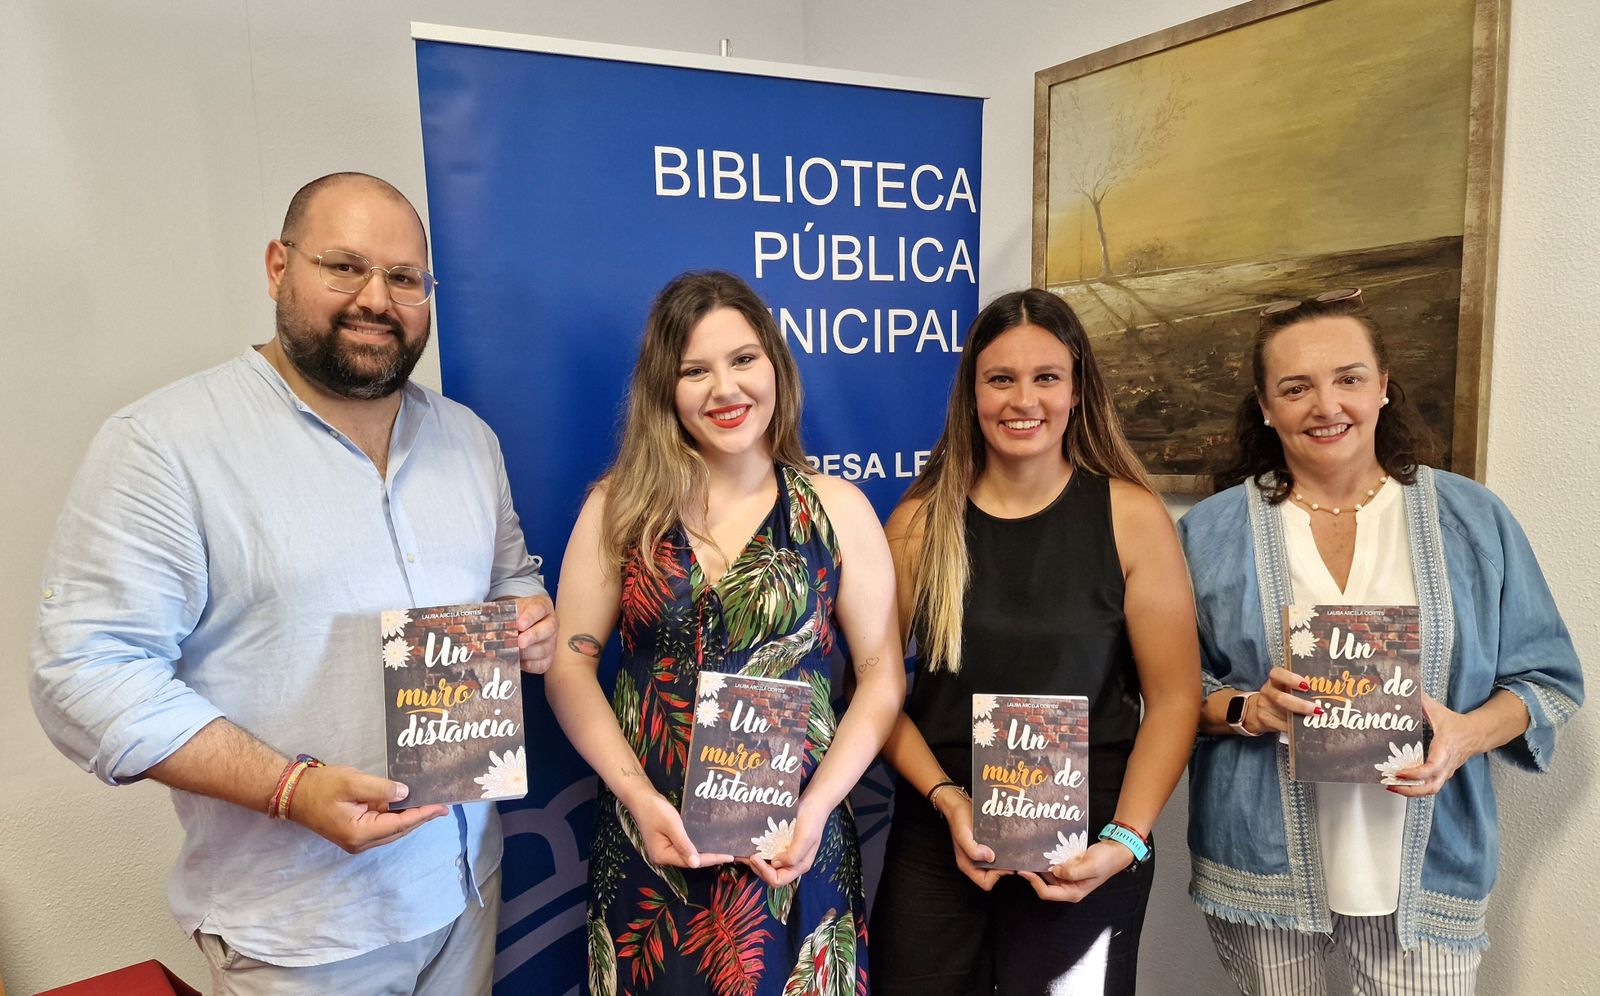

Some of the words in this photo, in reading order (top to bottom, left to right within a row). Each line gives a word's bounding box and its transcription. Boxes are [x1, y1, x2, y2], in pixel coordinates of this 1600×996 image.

[654, 145, 977, 214] BIBLIOTECA
[754, 222, 976, 284] PÚBLICA
[767, 307, 963, 355] NICIPAL
[424, 632, 474, 668] Un
[1329, 627, 1376, 660] Un
[396, 678, 474, 708] muro
[481, 667, 518, 700] de
[1304, 670, 1377, 697] muro
[1383, 666, 1418, 698] de
[397, 708, 520, 748] distancia
[730, 699, 771, 734] Un
[1007, 718, 1049, 751] Un
[700, 743, 766, 770] muro
[771, 742, 802, 774] de
[982, 760, 1048, 787] muro
[1054, 758, 1085, 789] de
[694, 769, 799, 808] distancia
[981, 787, 1086, 822] distancia
